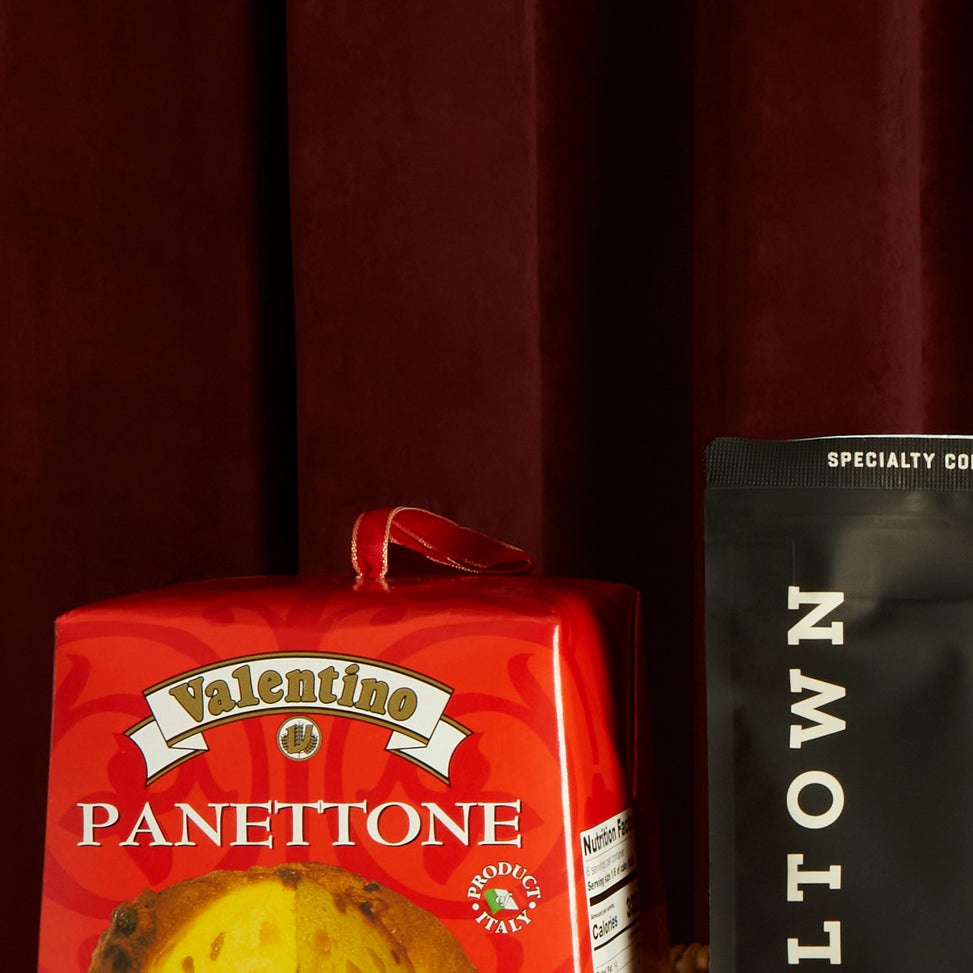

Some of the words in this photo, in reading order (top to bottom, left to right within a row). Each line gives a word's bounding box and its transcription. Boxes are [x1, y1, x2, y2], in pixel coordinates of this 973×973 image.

[827, 451, 935, 469] SPECIALTY
[168, 663, 418, 723] Valentino
[77, 799, 521, 849] PANETTONE
[583, 826, 616, 856] Nutrition
[467, 862, 541, 899] PRODUCT
[475, 910, 532, 934] ITALY
[592, 915, 618, 940] Calories
